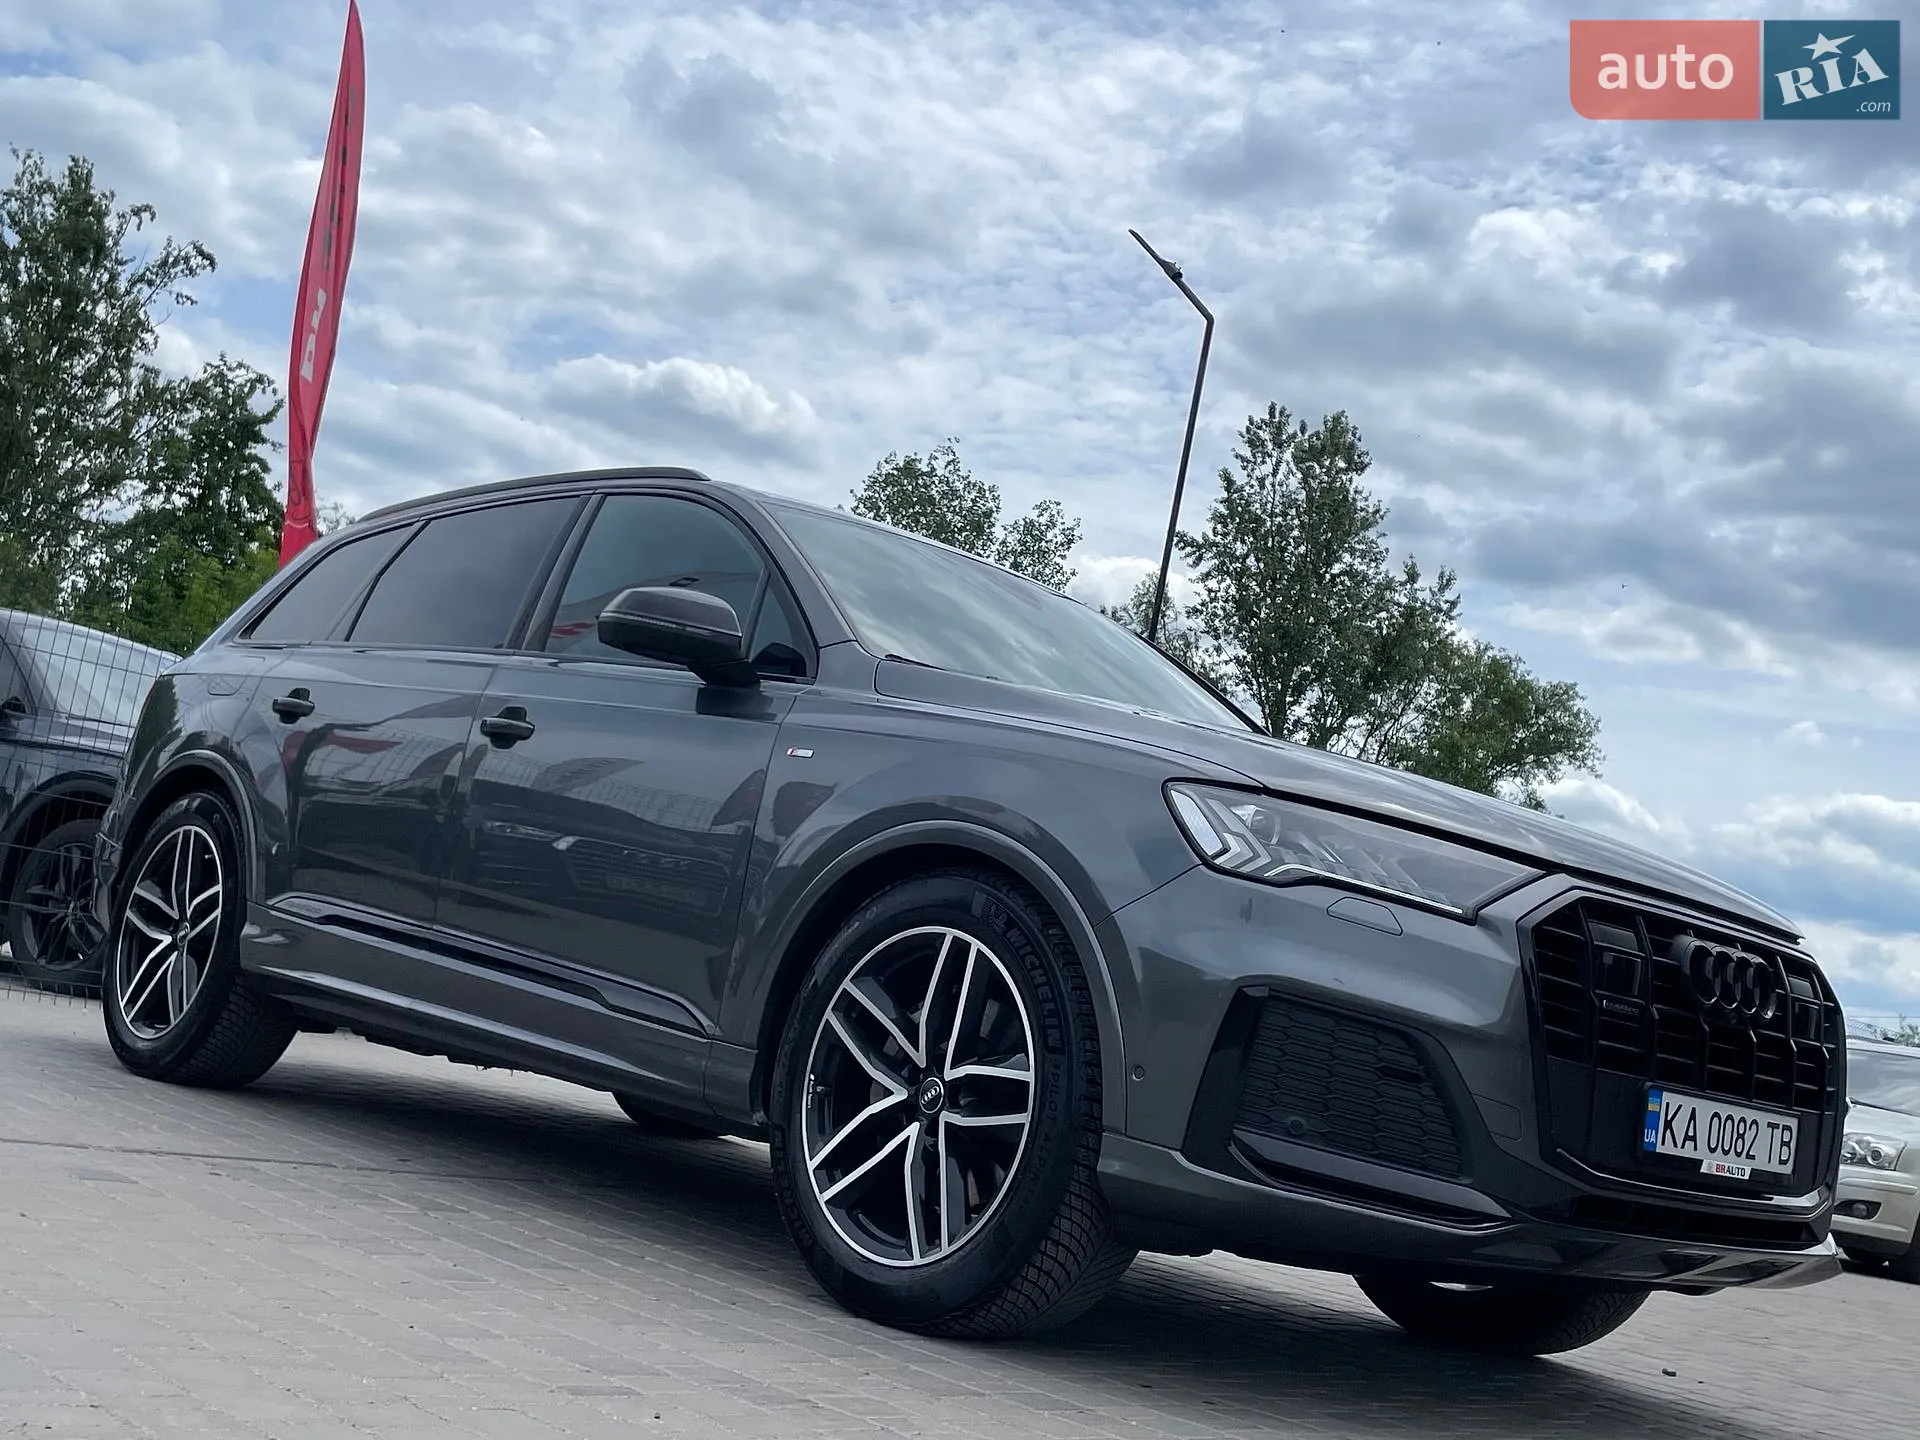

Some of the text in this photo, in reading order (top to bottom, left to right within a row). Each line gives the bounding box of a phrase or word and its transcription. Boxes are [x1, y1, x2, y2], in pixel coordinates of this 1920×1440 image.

[1006, 926, 1062, 1048] MICHELIN
[1644, 1128, 1656, 1143] UA
[1661, 1101, 1794, 1166] KA 0082 TB
